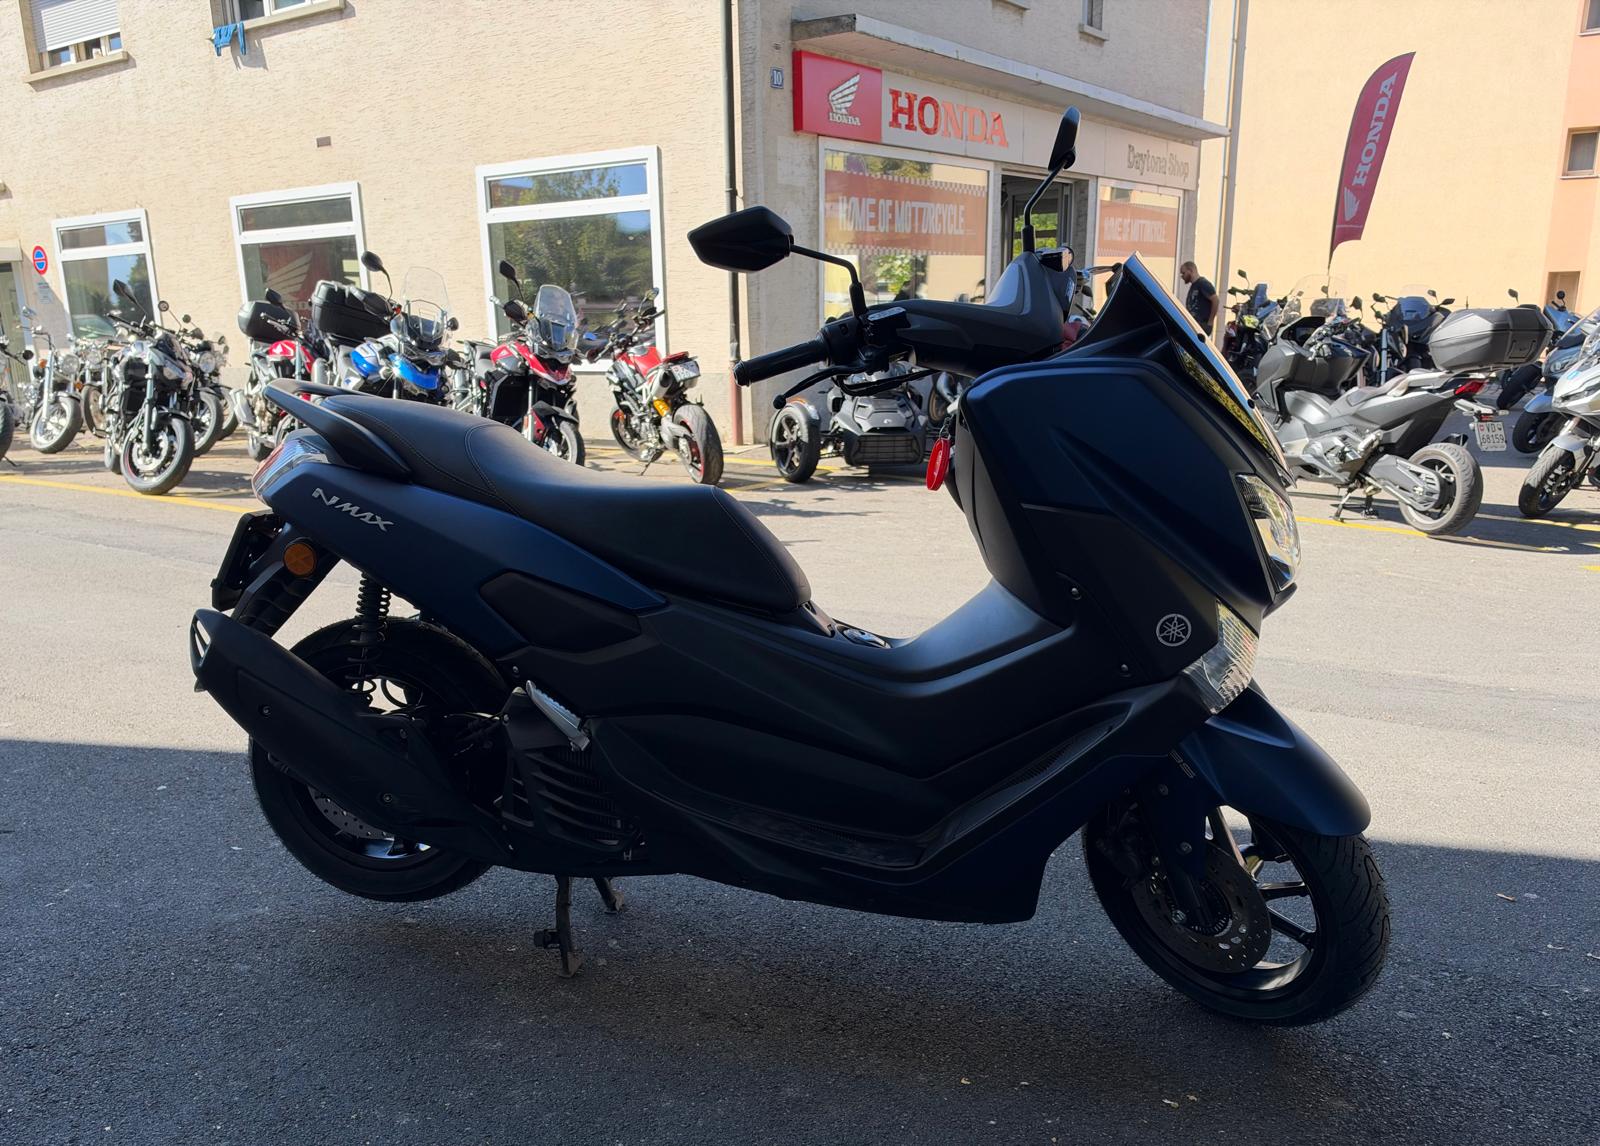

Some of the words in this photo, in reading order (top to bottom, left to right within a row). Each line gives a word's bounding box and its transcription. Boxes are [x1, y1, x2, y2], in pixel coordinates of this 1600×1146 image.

[773, 70, 783, 86] 10
[829, 112, 861, 126] HONDA
[889, 88, 1009, 149] HONDA
[1352, 72, 1397, 187] HONDA
[1127, 144, 1167, 176] Daytona
[1168, 153, 1190, 183] Shop
[838, 196, 877, 232] HOME
[878, 198, 893, 233] OF
[312, 487, 394, 532] NMAX
